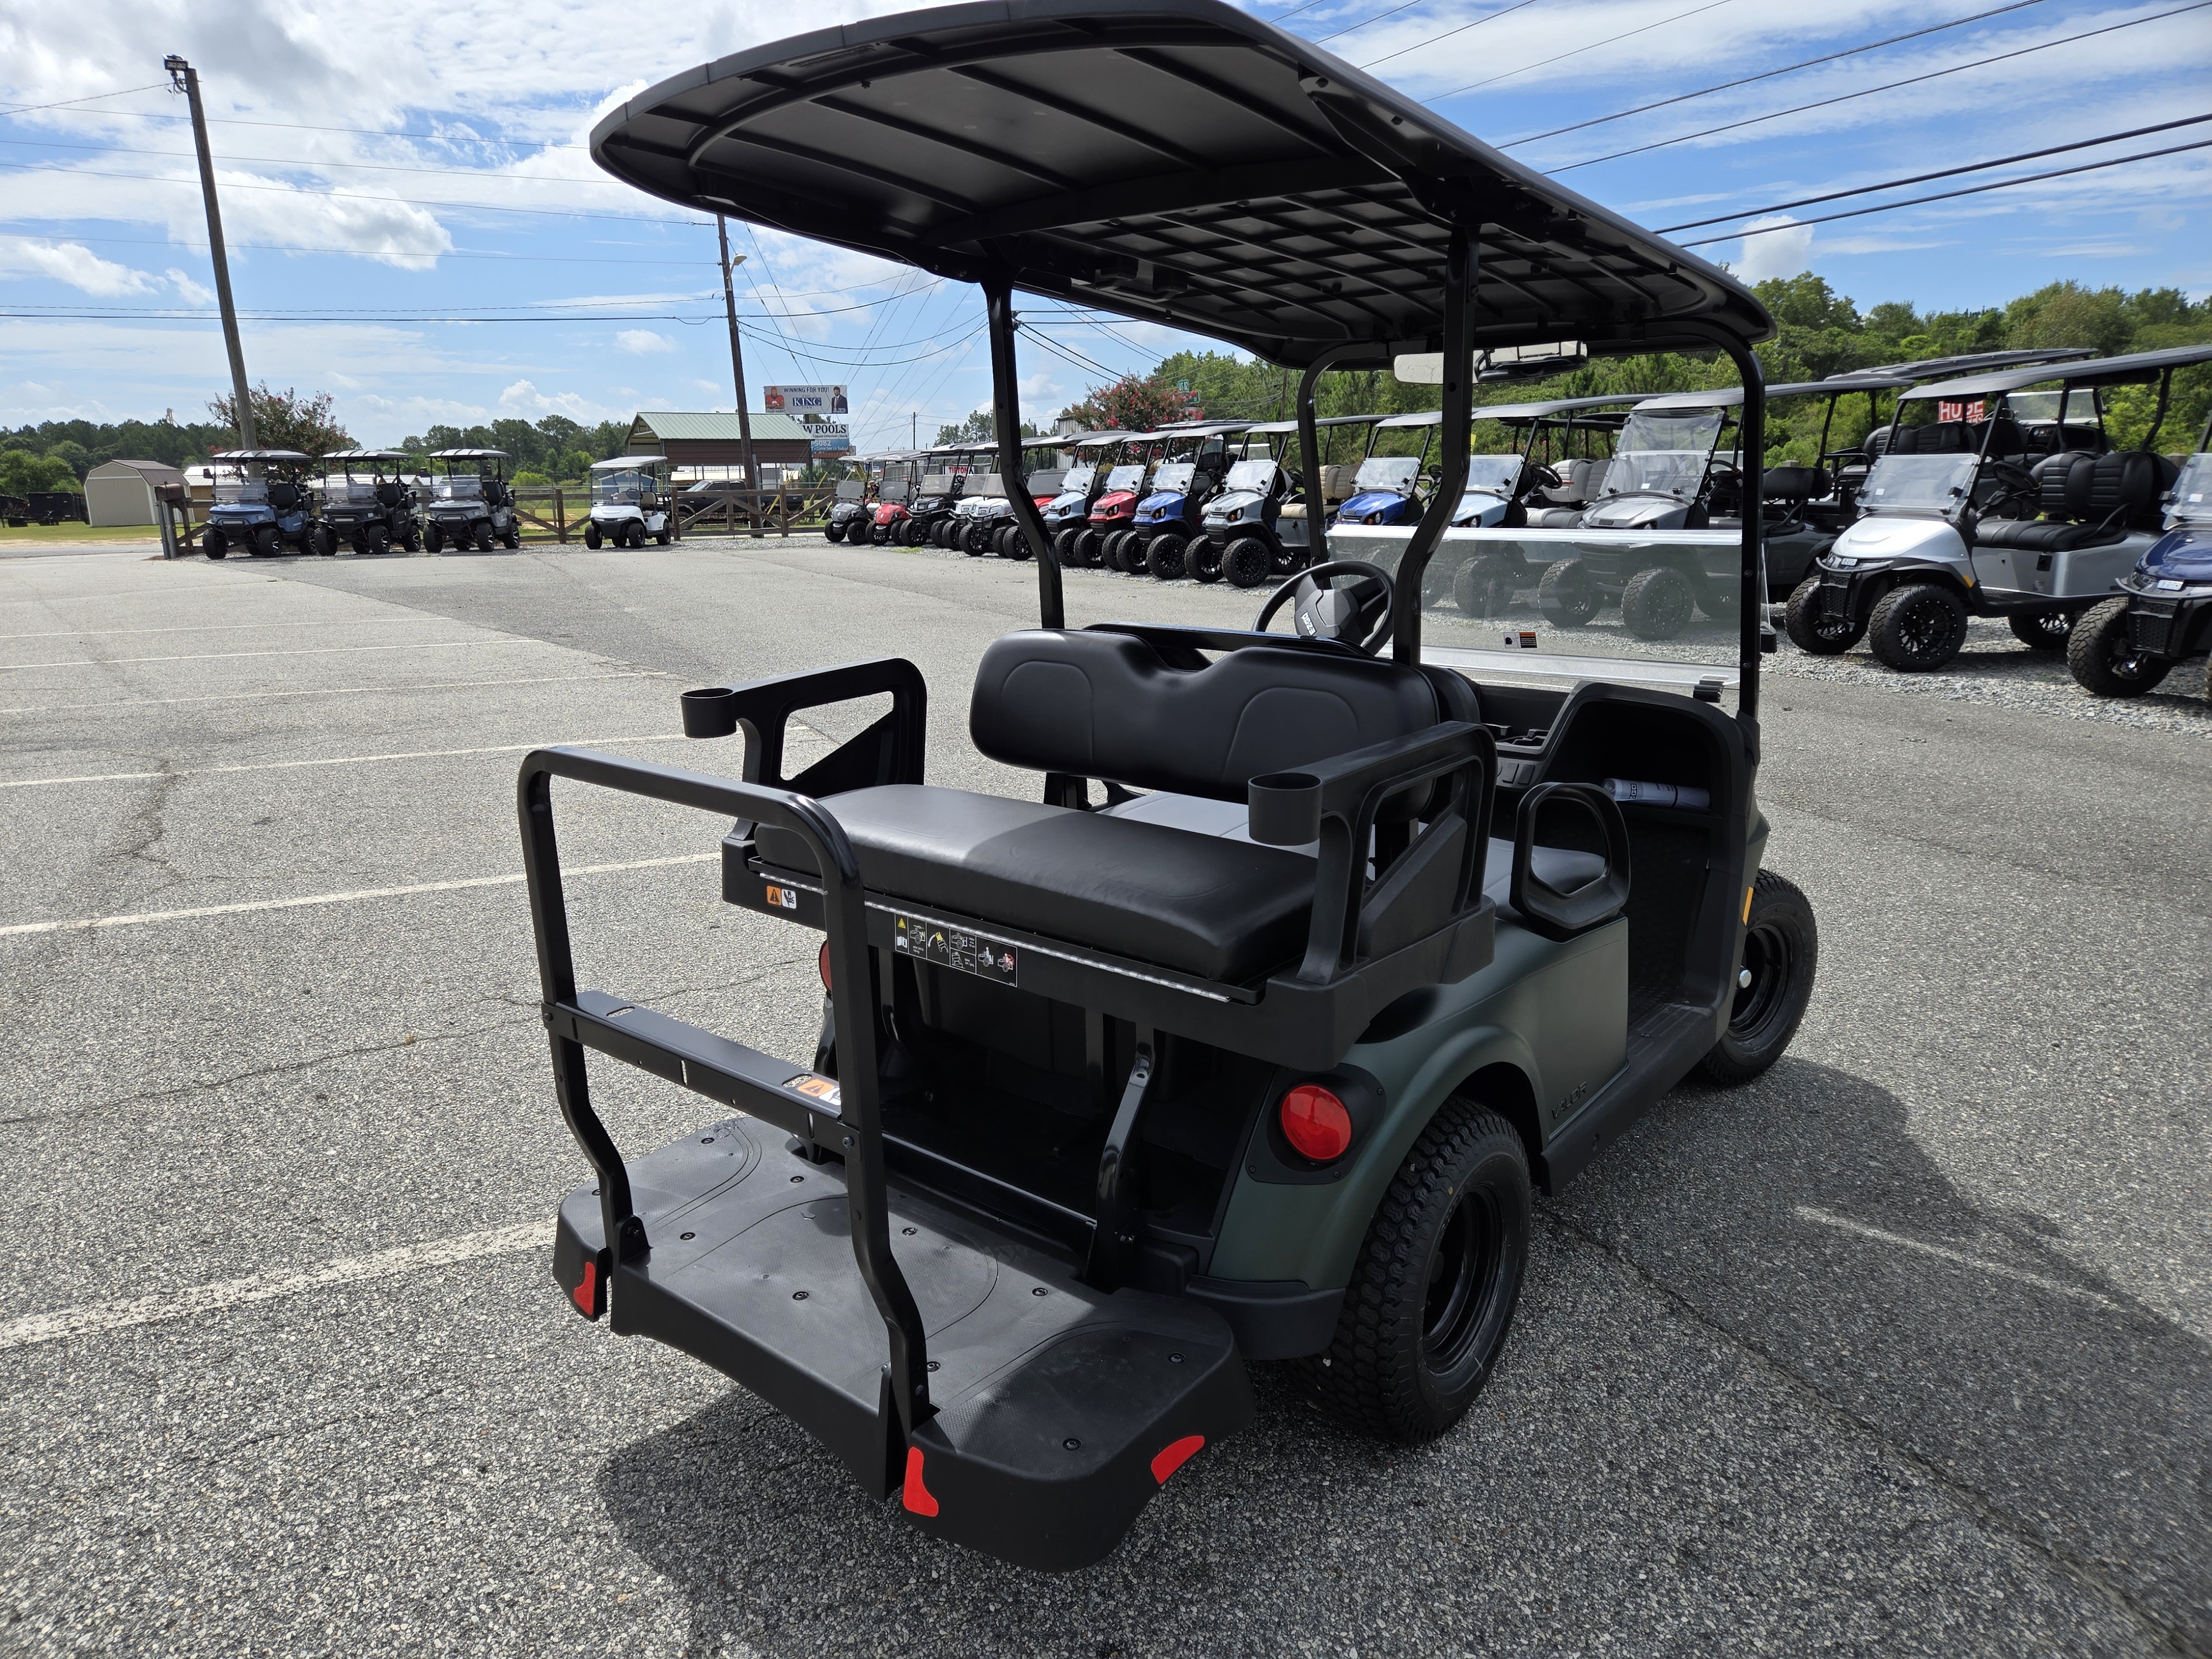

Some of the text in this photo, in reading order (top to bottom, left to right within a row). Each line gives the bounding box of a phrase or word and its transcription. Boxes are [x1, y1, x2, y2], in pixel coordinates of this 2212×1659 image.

[794, 398, 821, 406] KING
[1940, 401, 1984, 421] HUGE
[816, 425, 847, 434] POOLS
[1551, 1081, 1587, 1119] VALOR
